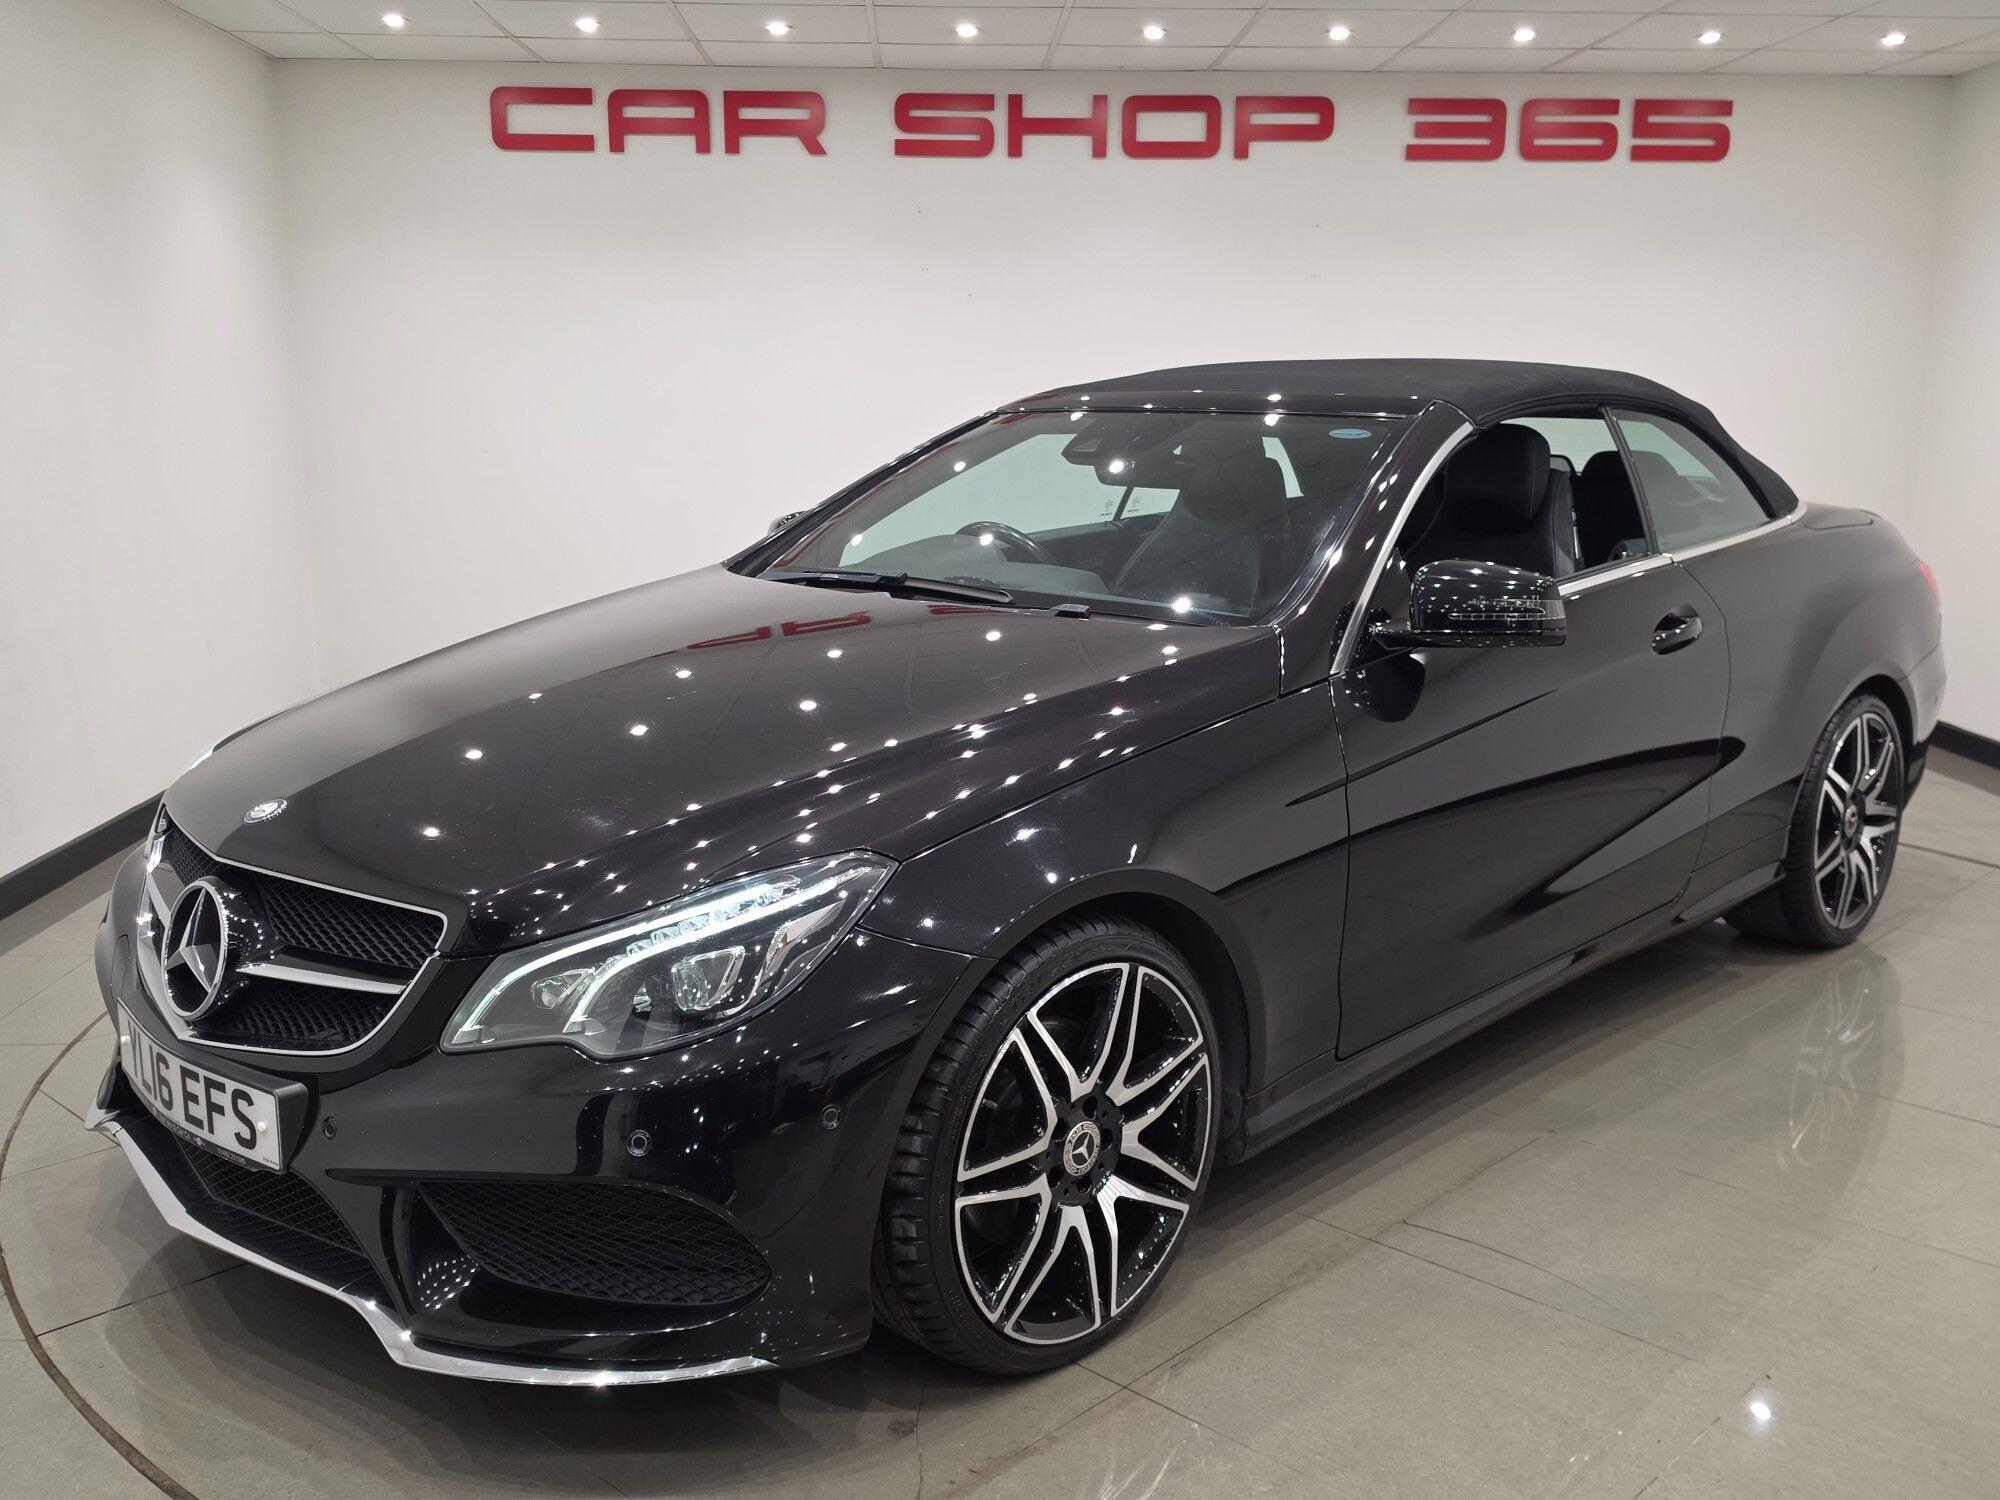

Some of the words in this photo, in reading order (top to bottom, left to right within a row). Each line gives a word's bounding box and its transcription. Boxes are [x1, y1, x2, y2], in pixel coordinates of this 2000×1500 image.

[491, 87, 826, 156] CAR
[894, 93, 1334, 159] SHOP
[1405, 98, 1733, 162] 365
[127, 1019, 174, 1112] YL16
[179, 1064, 258, 1151] EFS
